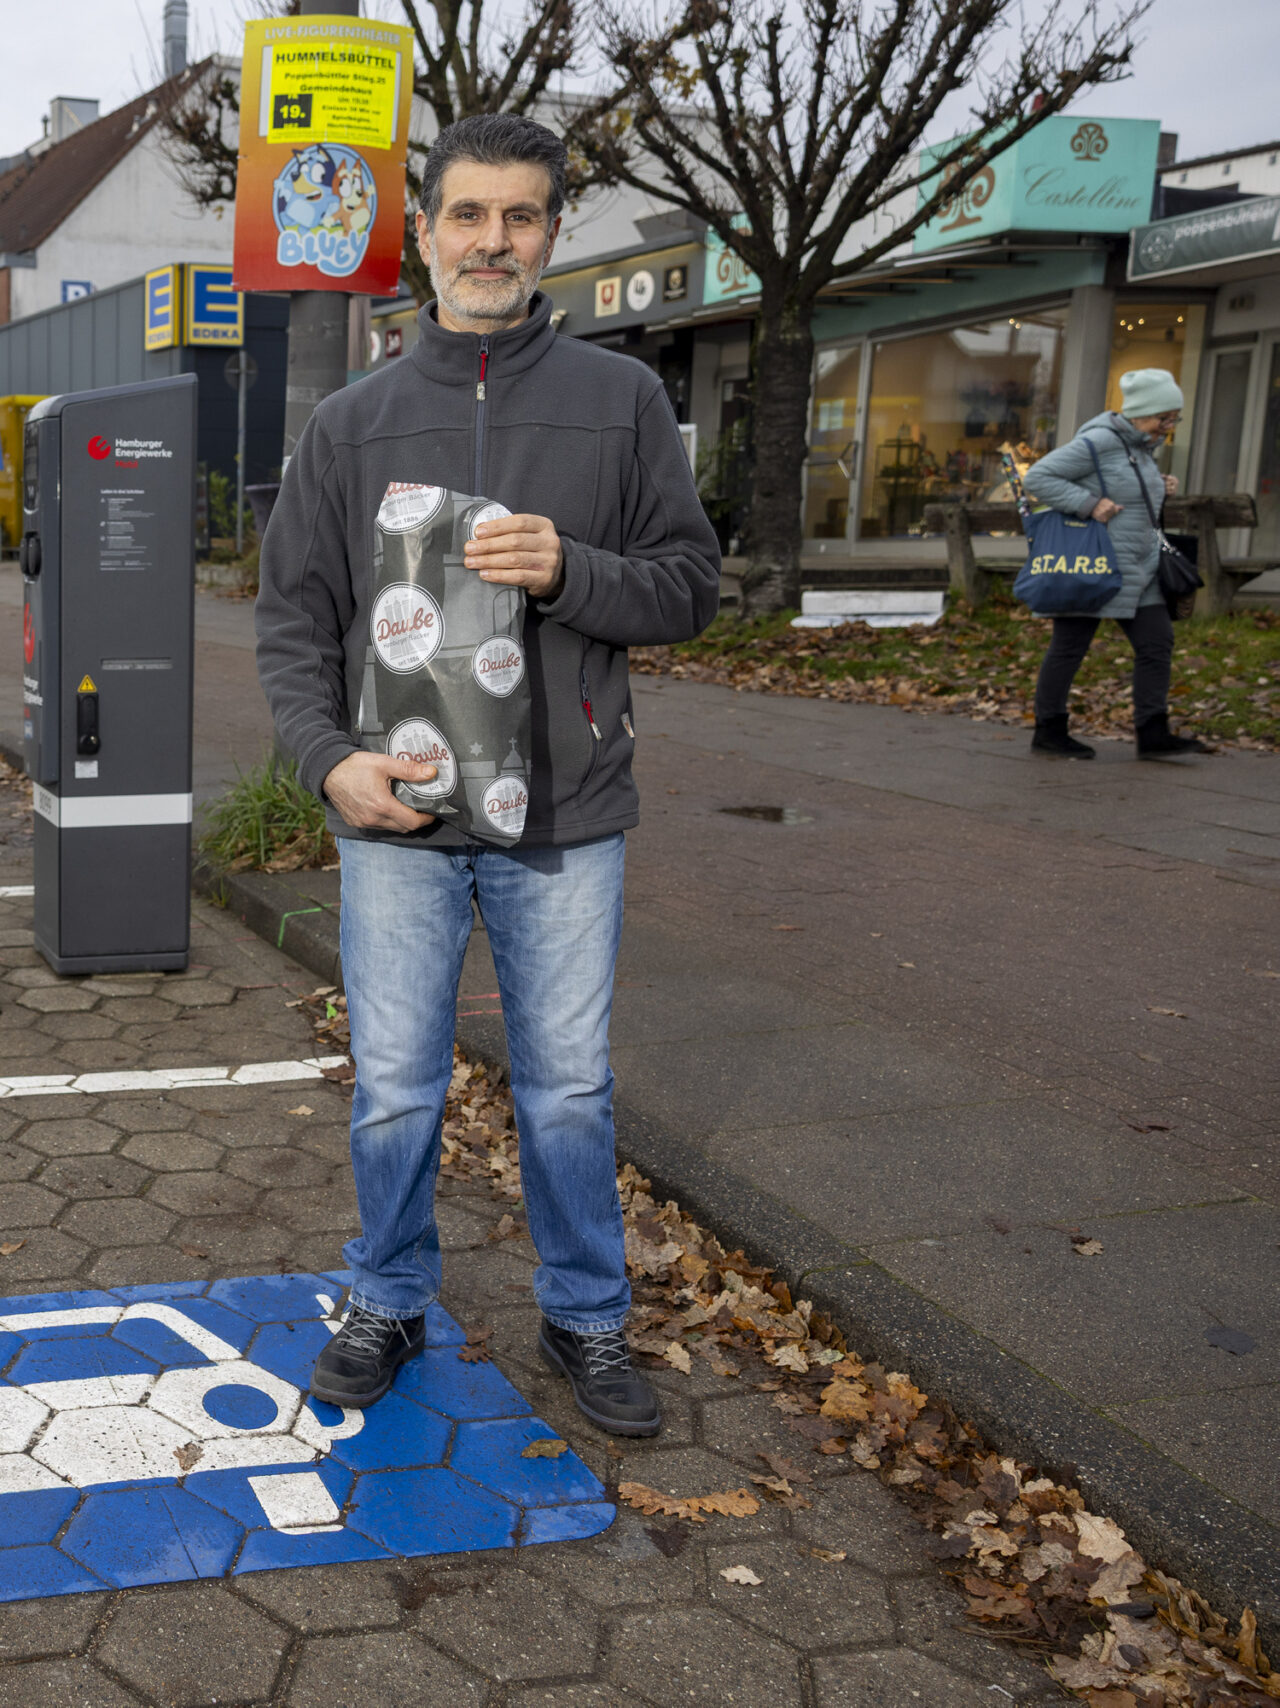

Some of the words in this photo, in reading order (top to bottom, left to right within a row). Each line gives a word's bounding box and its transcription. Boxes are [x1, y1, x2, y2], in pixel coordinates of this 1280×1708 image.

[265, 25, 400, 44] LIVE-FIGURENTHEATER
[276, 51, 394, 69] HUMMELSBÜTTEL
[299, 84, 372, 95] Gemeindehaus
[280, 104, 306, 119] 19.
[267, 228, 370, 277] BLUEY
[193, 328, 239, 339] EDEKA
[115, 438, 163, 450] Hamburger
[115, 448, 174, 460] Energiewerke
[1030, 554, 1113, 576] S.T.A.R.S.
[377, 607, 435, 642] Daube
[479, 652, 521, 675] Daube
[397, 743, 450, 764] Daube
[487, 791, 528, 815] Daube
